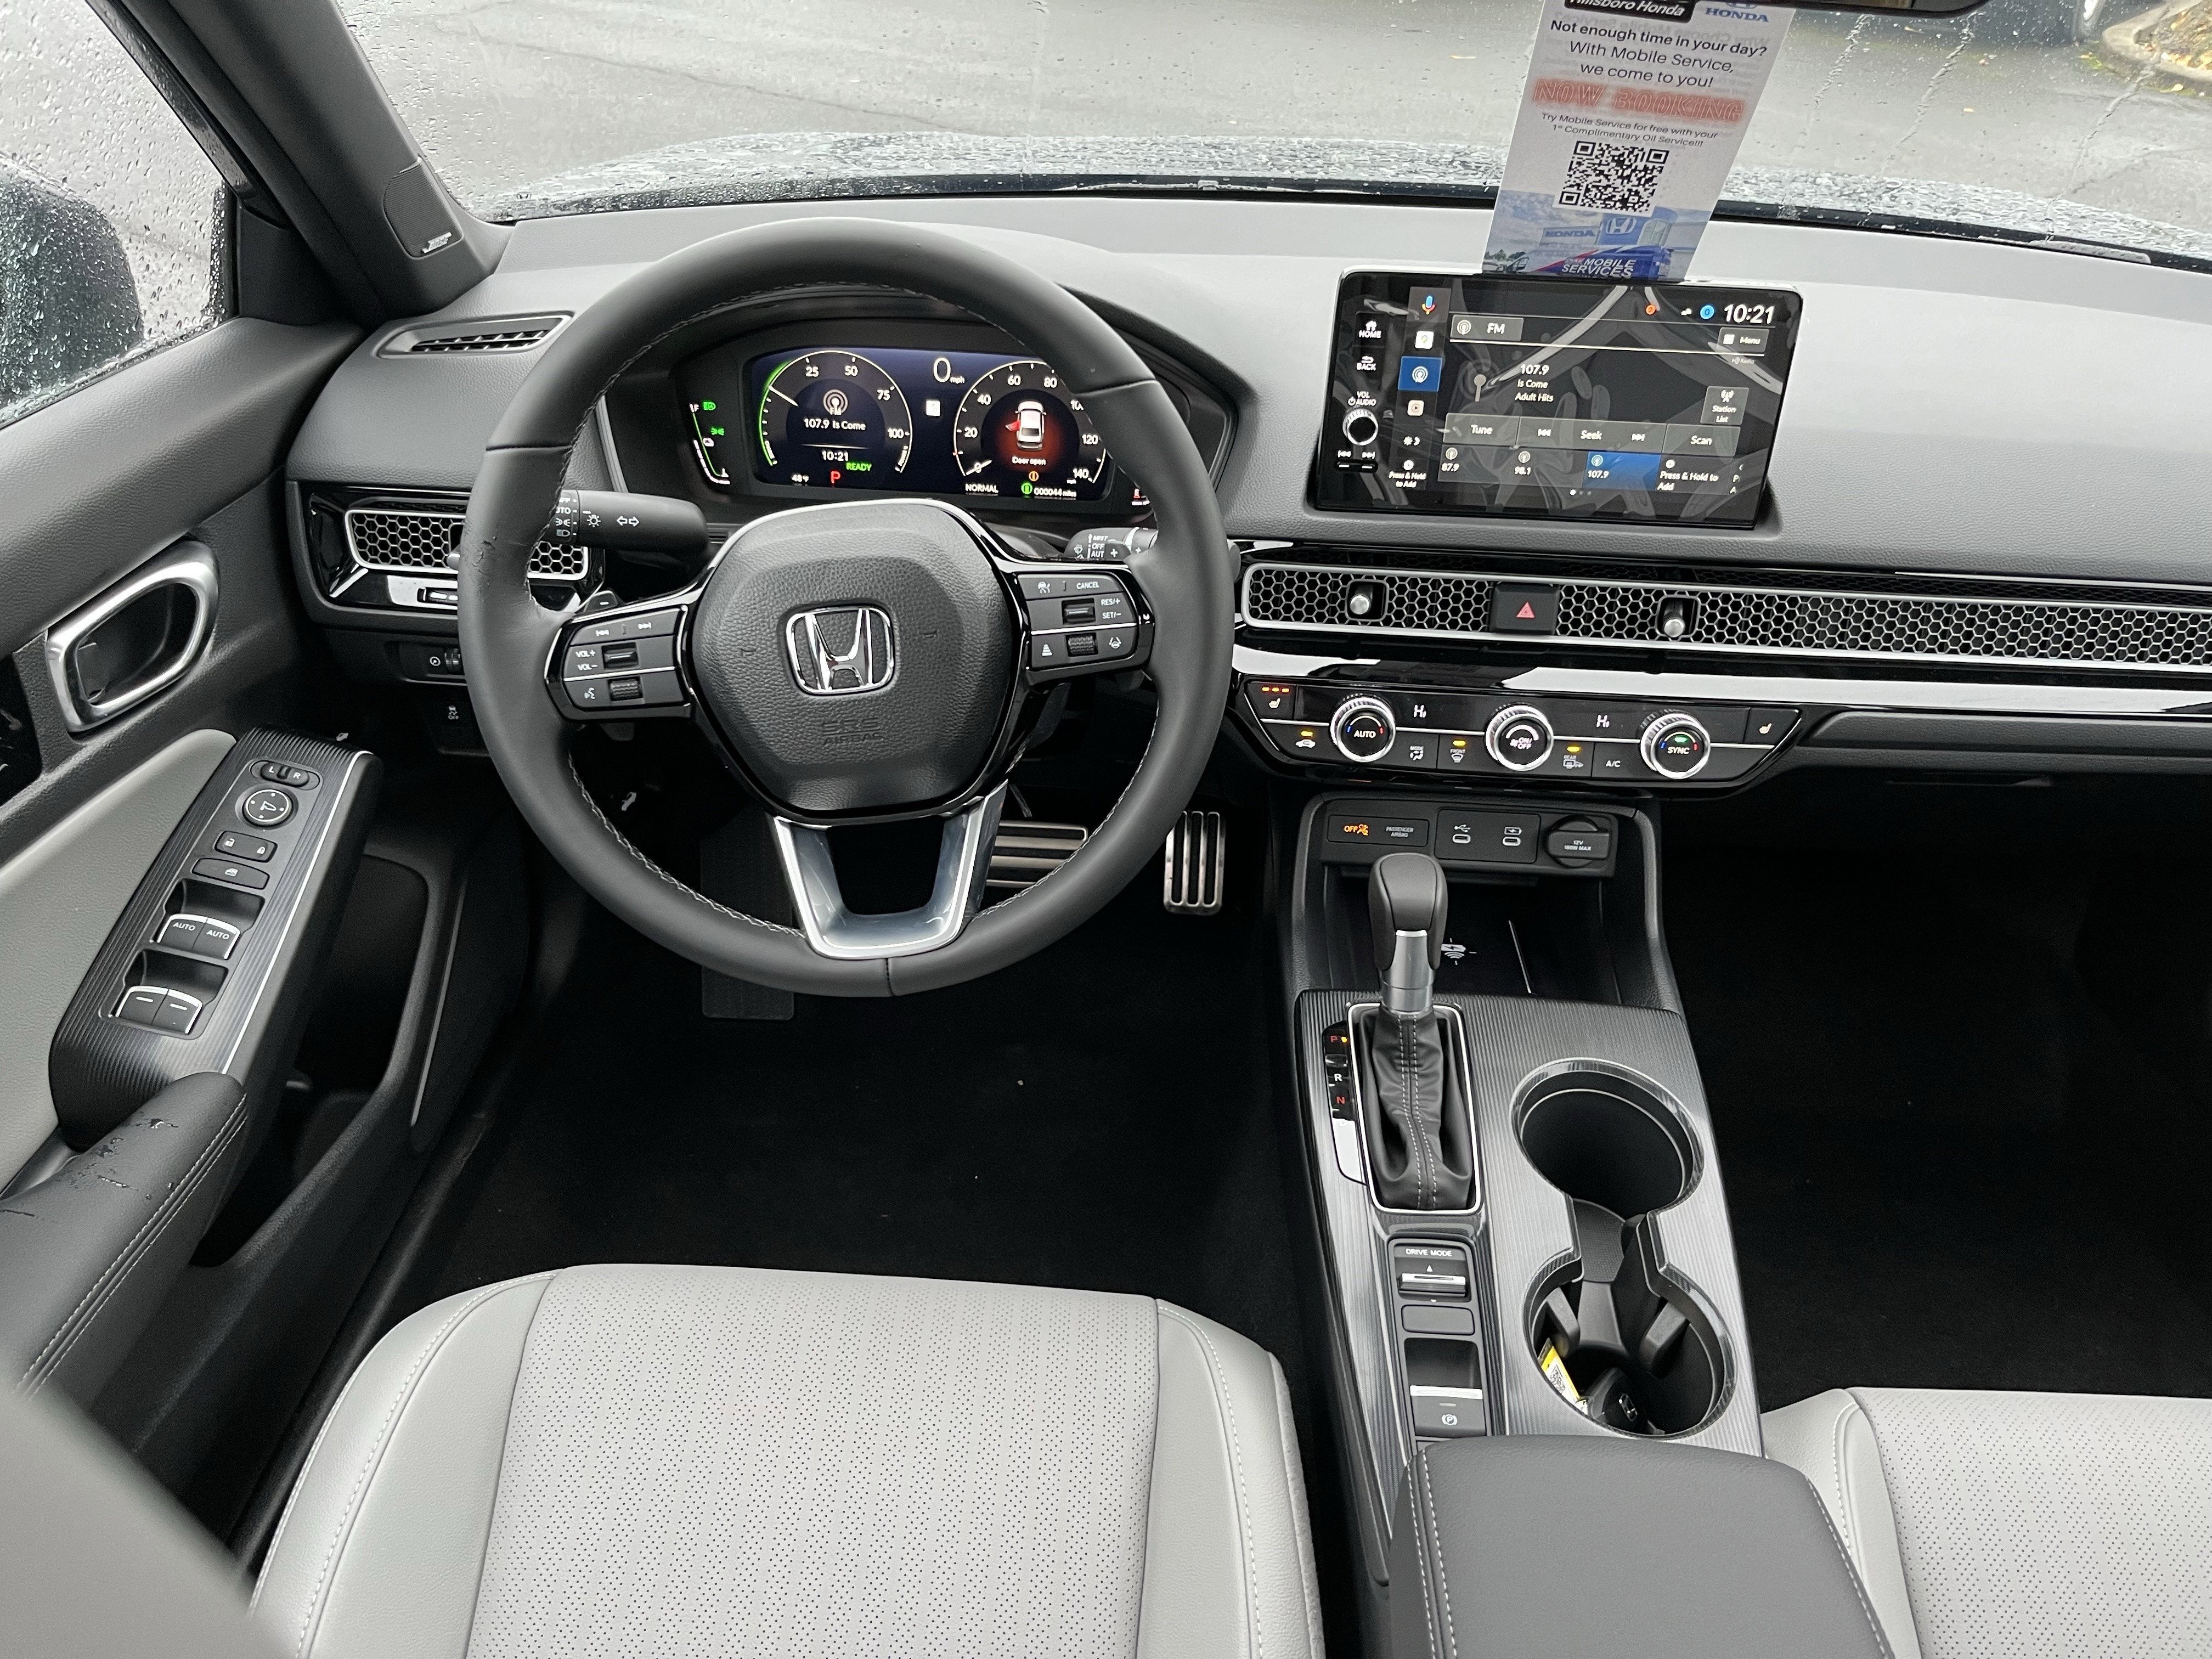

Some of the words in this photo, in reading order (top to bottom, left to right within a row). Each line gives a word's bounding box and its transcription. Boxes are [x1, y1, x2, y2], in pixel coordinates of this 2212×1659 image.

[1570, 0, 1635, 10] sboro
[1636, 1, 1685, 16] Honda
[1705, 7, 1769, 22] HONDA
[1550, 20, 1577, 33] Not
[1579, 25, 1637, 42] enough
[1640, 32, 1673, 45] time
[1675, 35, 1690, 47] in
[1691, 40, 1728, 51] your
[1729, 43, 1768, 58] day?
[1570, 41, 1606, 57] With
[1611, 46, 1667, 64] Mobile
[1671, 54, 1734, 74] Service,
[1580, 63, 1604, 75] we
[1607, 66, 1652, 81] come
[1657, 72, 1673, 83] to
[1678, 75, 1714, 88] you!
[1533, 80, 1605, 107] NOW
[1613, 88, 1745, 122] BOOKING
[1542, 112, 1558, 122] Try
[1559, 115, 1593, 125] Mobile
[1595, 119, 1632, 129] Service
[1634, 122, 1647, 131] for
[1649, 125, 1669, 133] free
[1565, 126, 1641, 142] Complimentary
[1643, 134, 1656, 142] Oil
[1658, 136, 1703, 148] Service!!!
[1583, 258, 1637, 268] MOBILE
[1561, 264, 1634, 279] SERVICES
[1724, 303, 1775, 324] 10:21
[1487, 323, 1505, 334] FM
[1358, 330, 1382, 338] HOME
[1739, 336, 1760, 345] Menu
[805, 366, 820, 377] 25
[844, 365, 859, 376] 50
[933, 357, 951, 382] 0
[950, 376, 965, 384] mph
[1356, 363, 1376, 371] BACK
[1520, 364, 1550, 375] 107.9
[1007, 375, 1021, 386] 60
[1043, 377, 1058, 388] 80
[1525, 380, 1549, 388] Come
[877, 390, 890, 401] 75
[977, 394, 992, 405] 40
[1514, 392, 1537, 402] Adult
[1537, 393, 1554, 403] Hits
[1356, 398, 1376, 407] AUDIO
[830, 408, 842, 416] FM
[1712, 405, 1736, 413] Station
[803, 418, 830, 430] 107.9
[842, 420, 866, 430] Come
[887, 428, 905, 439] 100
[964, 427, 978, 438] 20
[1470, 424, 1493, 435] Tune
[1081, 435, 1098, 445] 120
[1580, 430, 1602, 440] Seek
[1690, 435, 1713, 445] Scan
[821, 450, 849, 461] 10:21
[1012, 456, 1029, 465] Door
[845, 461, 872, 471] READY
[1441, 462, 1460, 472] 87.9
[1514, 466, 1531, 476] 98.1
[830, 470, 841, 484] P
[1073, 468, 1090, 478] 140
[1587, 470, 1610, 479] 107.9
[1660, 471, 1681, 481] Press
[1689, 472, 1708, 482] Hold
[965, 483, 999, 493] NORMAL
[1657, 482, 1675, 491] Add
[1034, 488, 1062, 496] 000044
[556, 506, 571, 515] UTO
[1076, 581, 1099, 590] CANCEL
[1353, 730, 1376, 738] AUTO
[1667, 746, 1690, 755] SYNC
[1605, 760, 1621, 768] A/C
[268, 765, 275, 774] L
[173, 922, 196, 932] AUTO
[206, 929, 230, 940] AUTO
[1334, 1073, 1342, 1082] R
